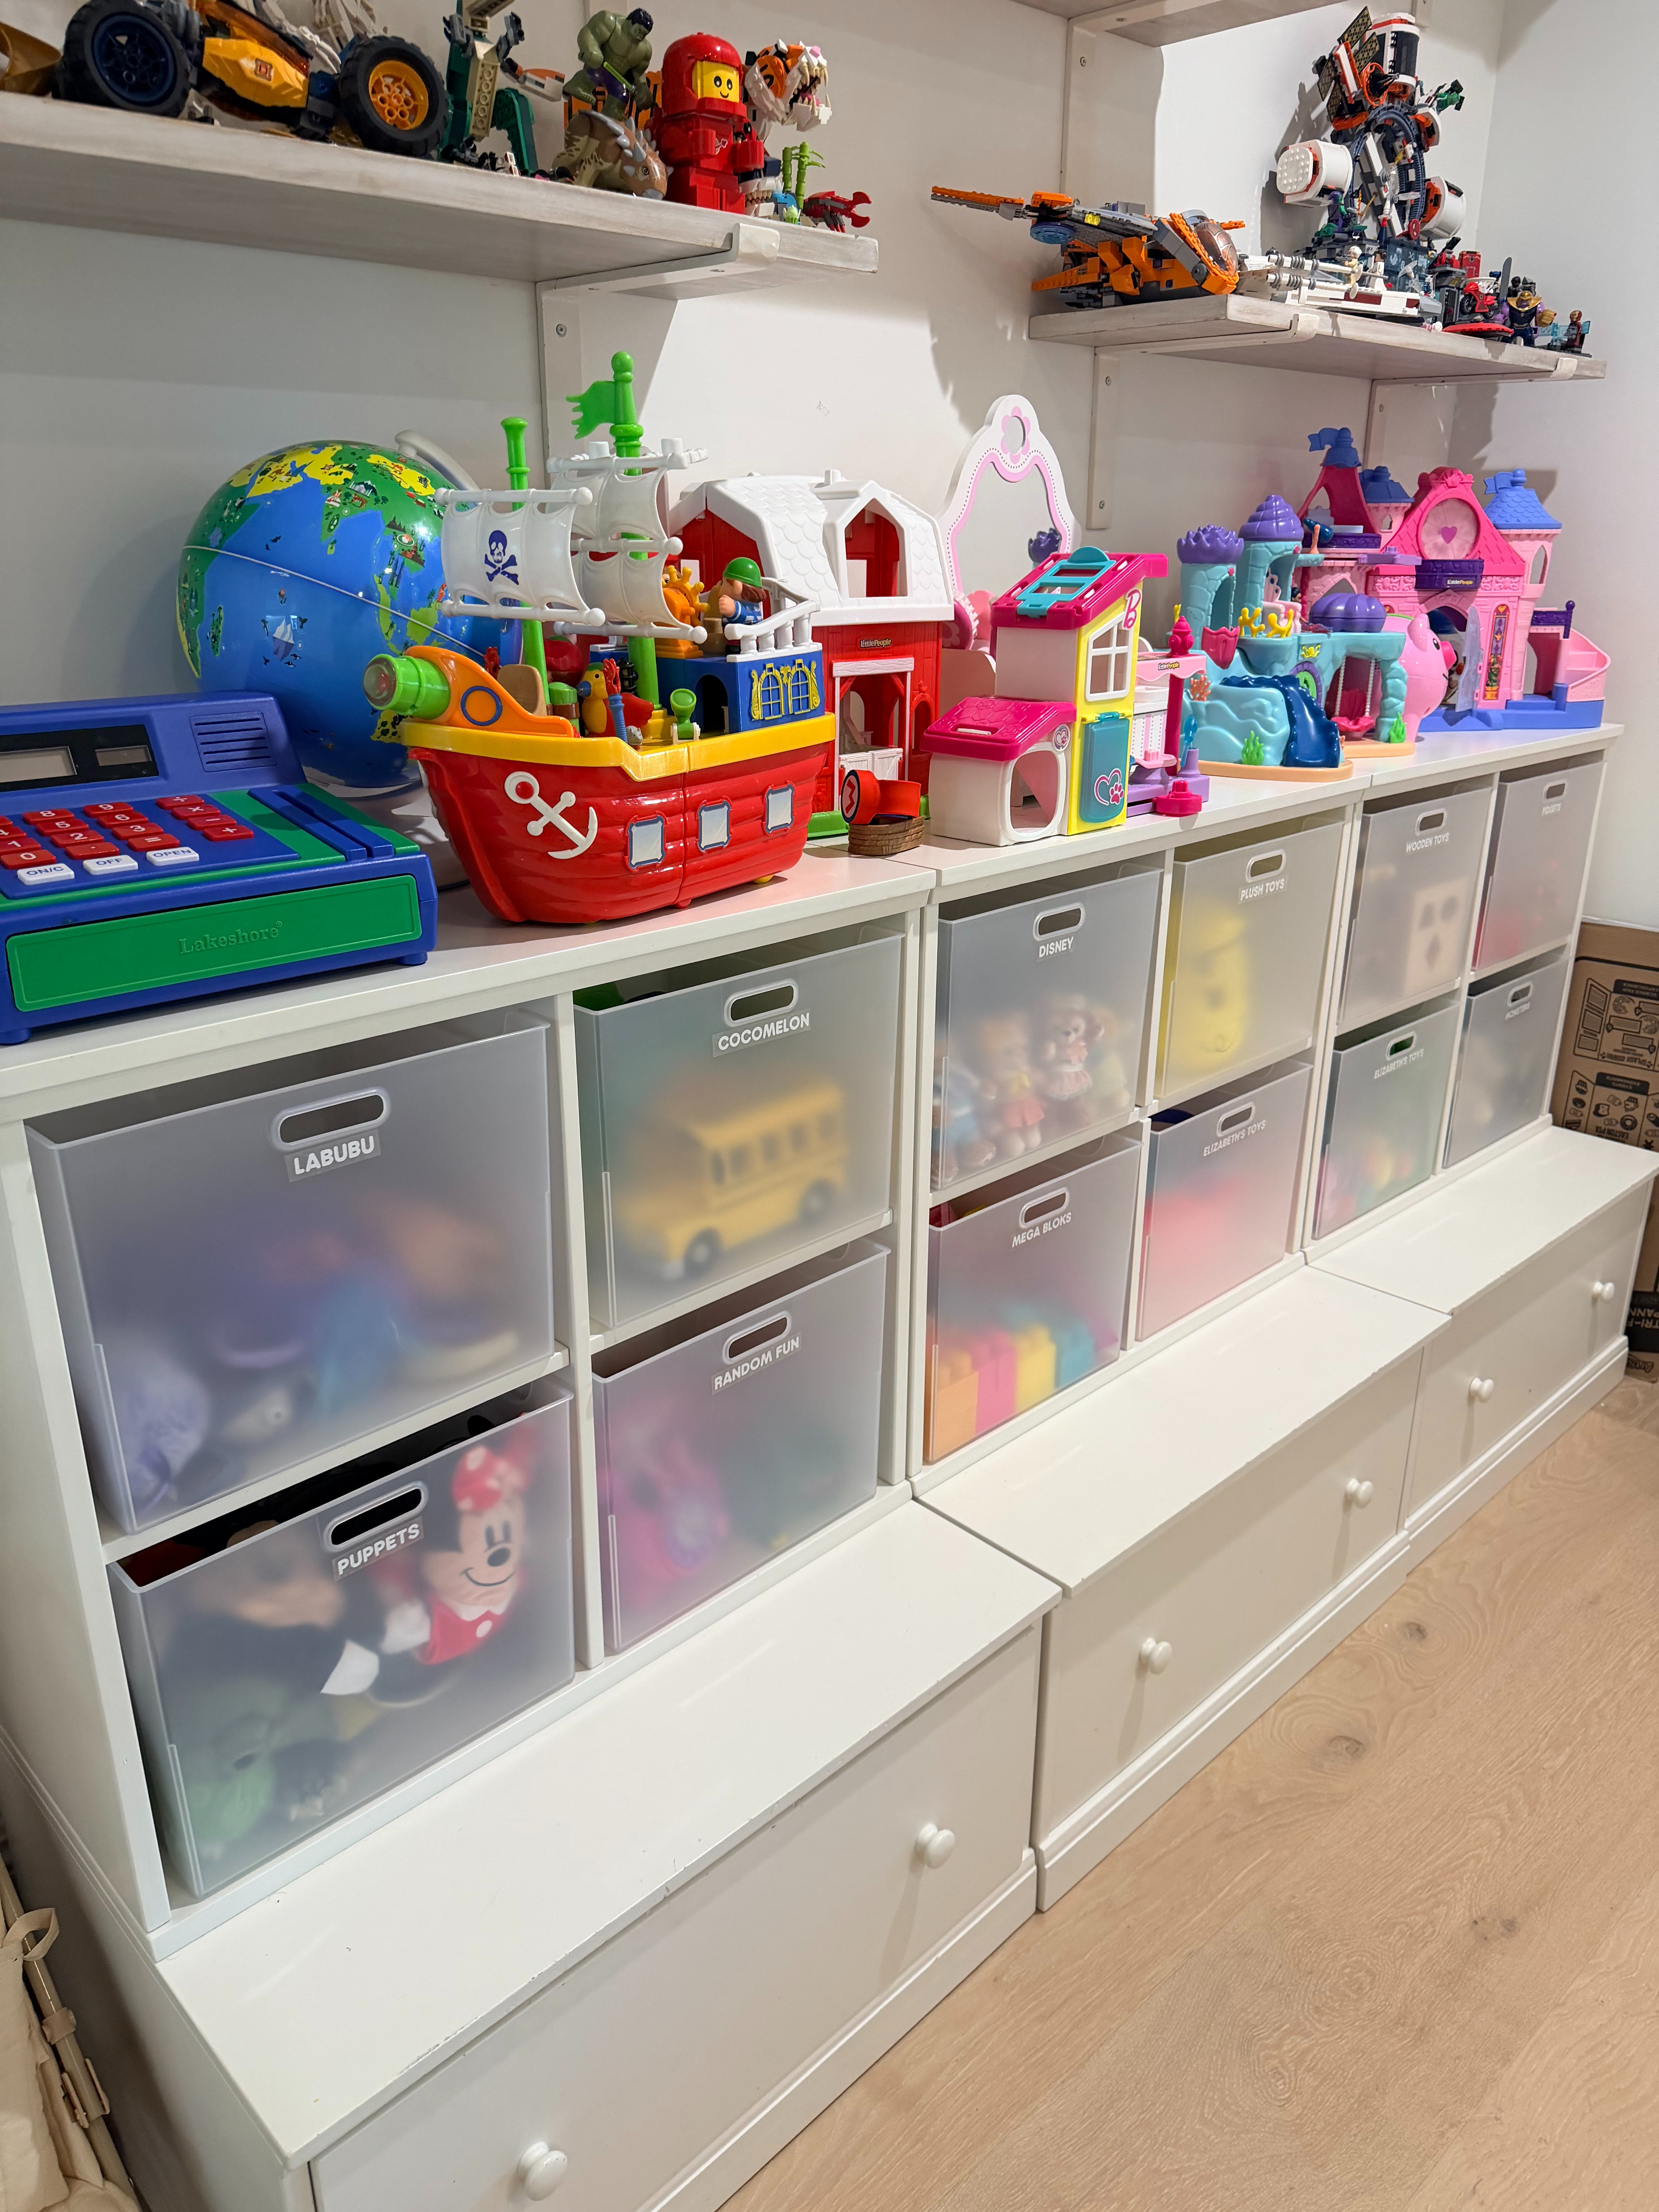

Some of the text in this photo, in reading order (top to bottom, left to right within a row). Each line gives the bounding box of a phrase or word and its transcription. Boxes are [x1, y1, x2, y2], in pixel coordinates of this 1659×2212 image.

[1406, 833, 1450, 853] WOODEN TOYS
[27, 866, 64, 875] ON/C
[1240, 878, 1285, 901] PLUSH TOYS
[1039, 936, 1073, 958] DISNEY
[718, 1012, 809, 1051] COCOMELON
[1374, 1049, 1424, 1079] ELIZABETH'S TOYS
[294, 1135, 374, 1175] LABUBU
[1204, 1120, 1266, 1157] ELIZABETH'S TOYS
[1012, 1212, 1072, 1248] MEGA BLOKS
[714, 1336, 799, 1390] RANDOM FUN
[338, 1523, 420, 1575] PUPPETS
